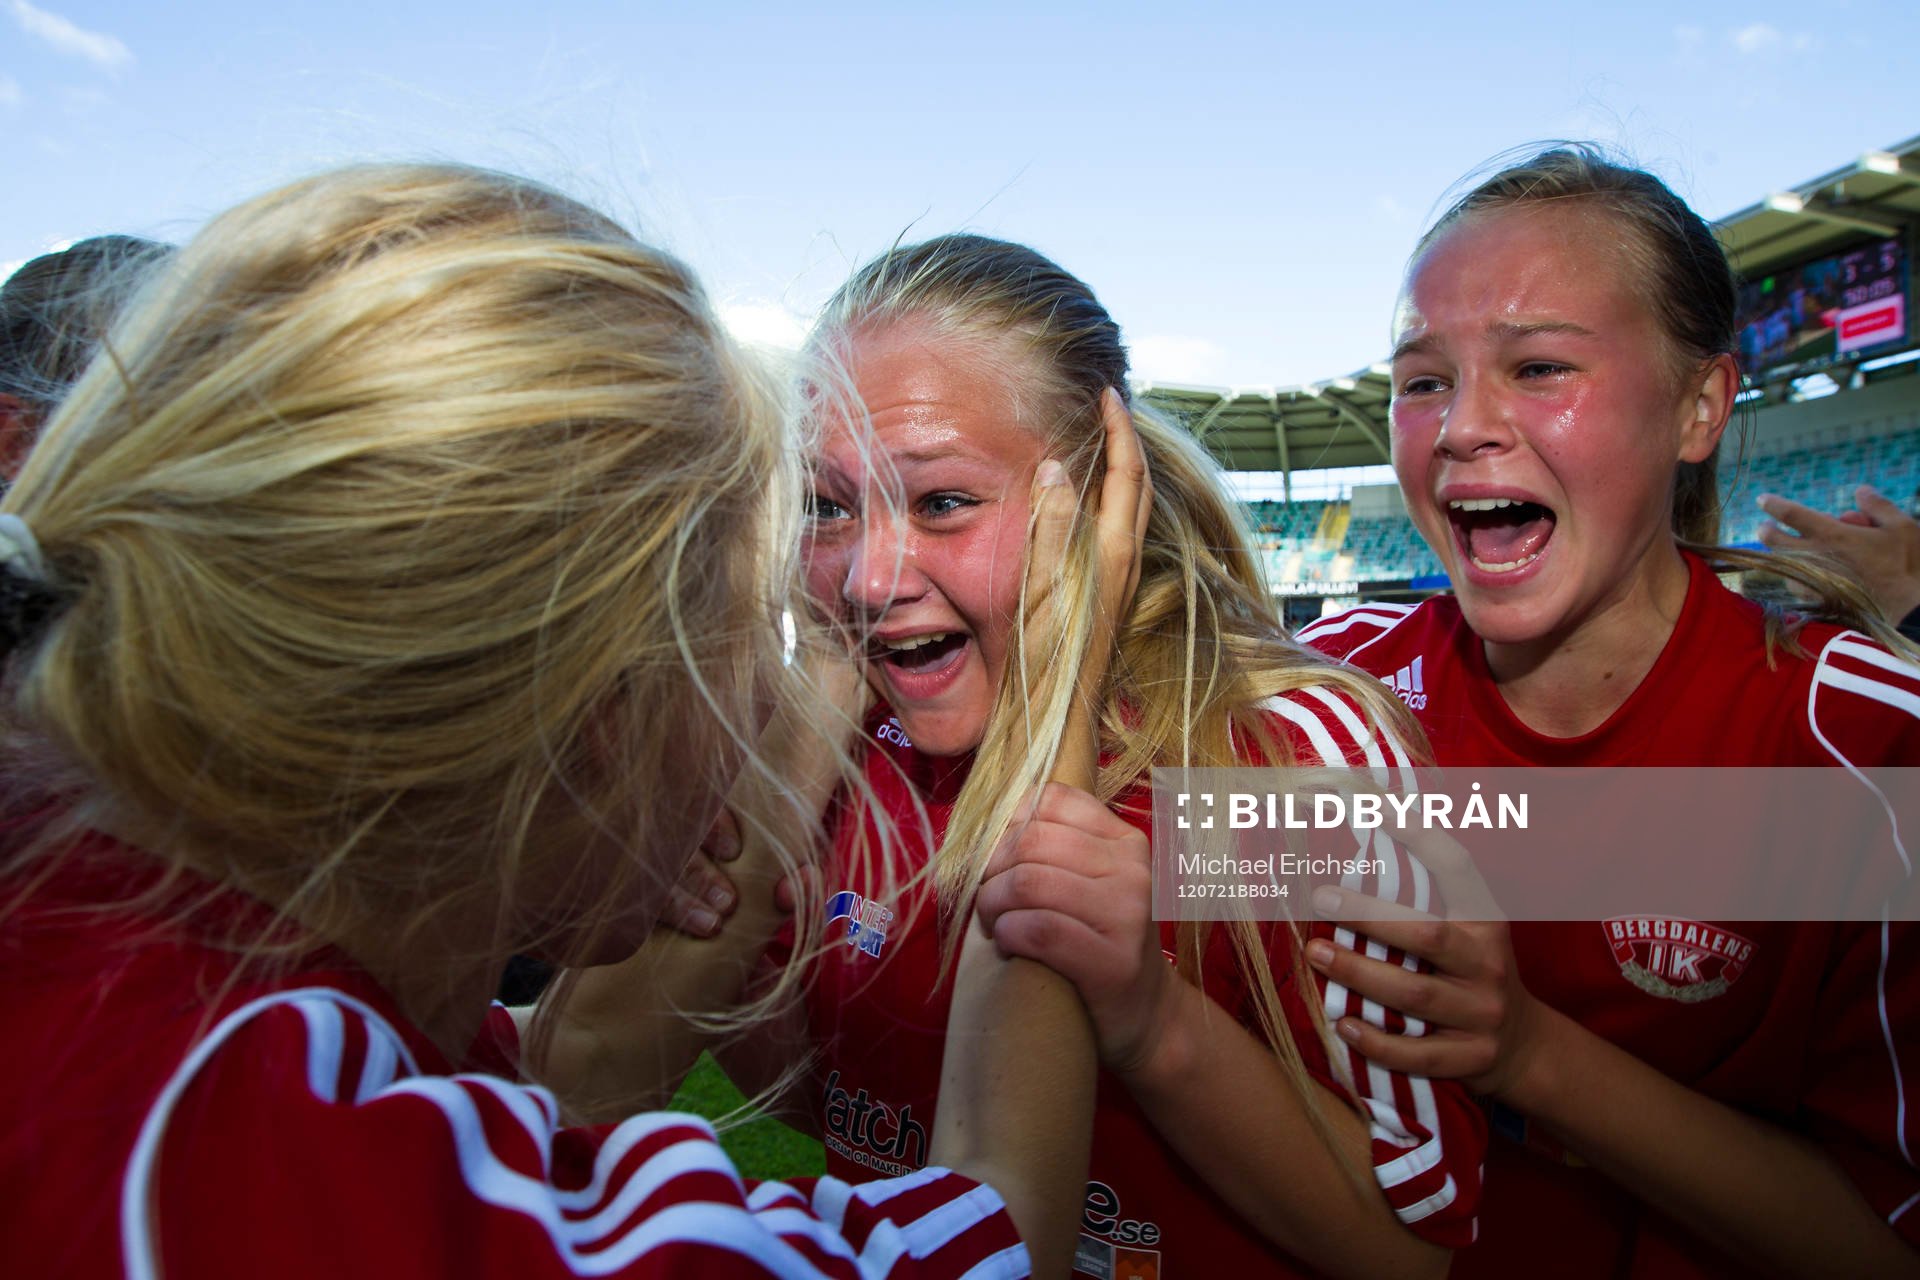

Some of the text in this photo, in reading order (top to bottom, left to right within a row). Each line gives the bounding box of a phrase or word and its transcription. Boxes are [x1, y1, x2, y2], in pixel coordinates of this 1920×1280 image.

[1611, 919, 1752, 962] BERGDALENS
[1650, 943, 1706, 982] IK
[853, 1150, 870, 1167] OR
[871, 1155, 901, 1177] MAKE
